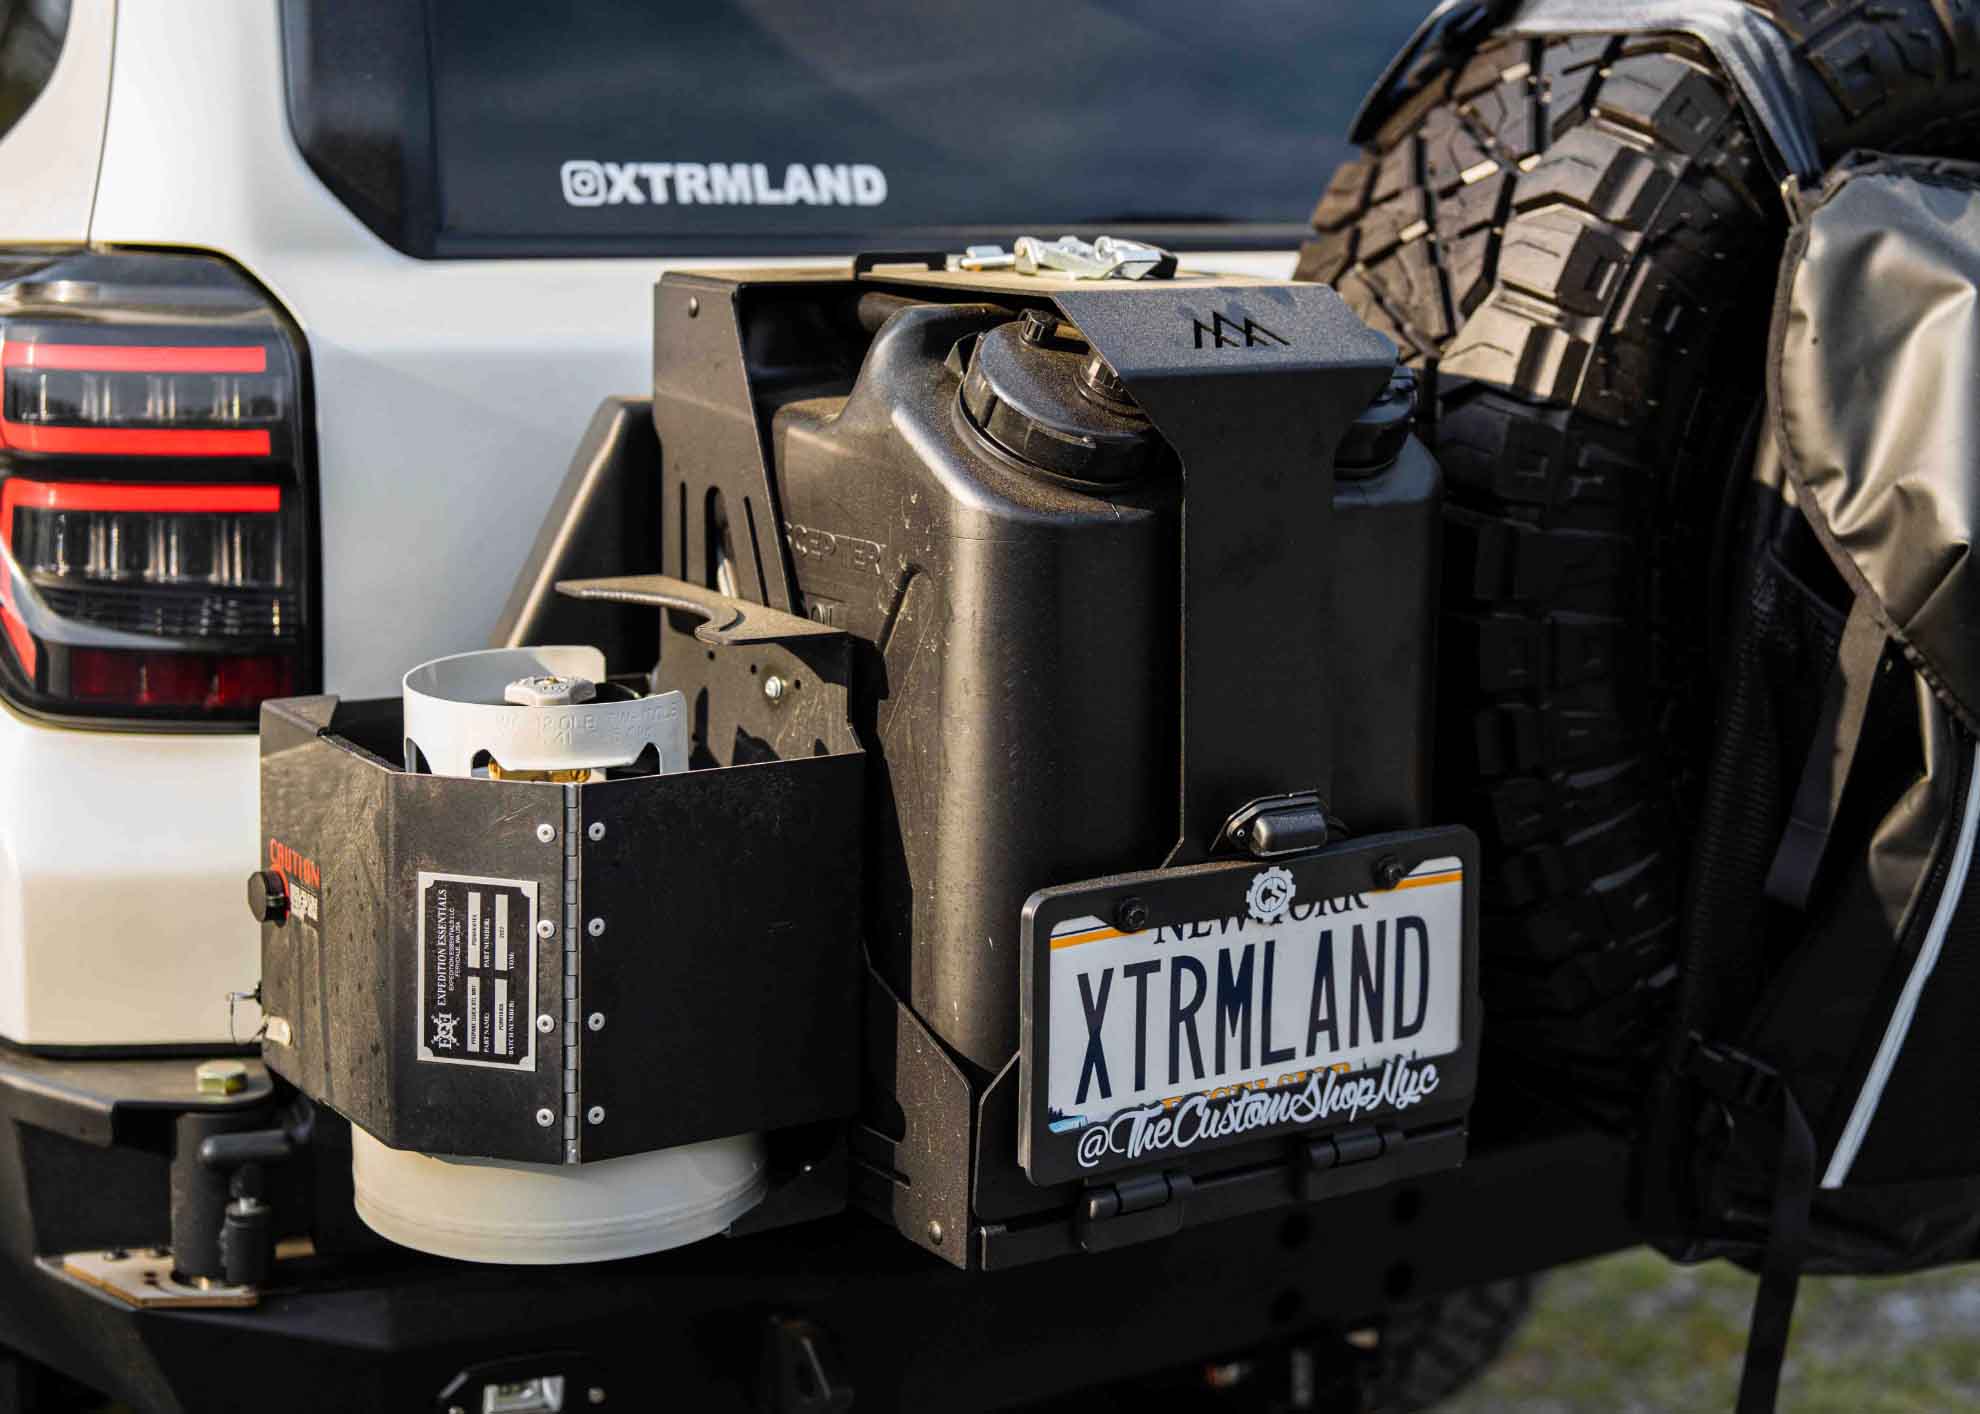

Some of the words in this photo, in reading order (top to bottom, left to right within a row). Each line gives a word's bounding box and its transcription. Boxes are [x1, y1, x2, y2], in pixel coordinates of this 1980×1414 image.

[604, 162, 888, 206] XTRMLAND
[437, 889, 447, 946] ESSENTIALS
[437, 948, 447, 1007] EXPEDITION
[1074, 915, 1430, 1106] XTRMLAND
